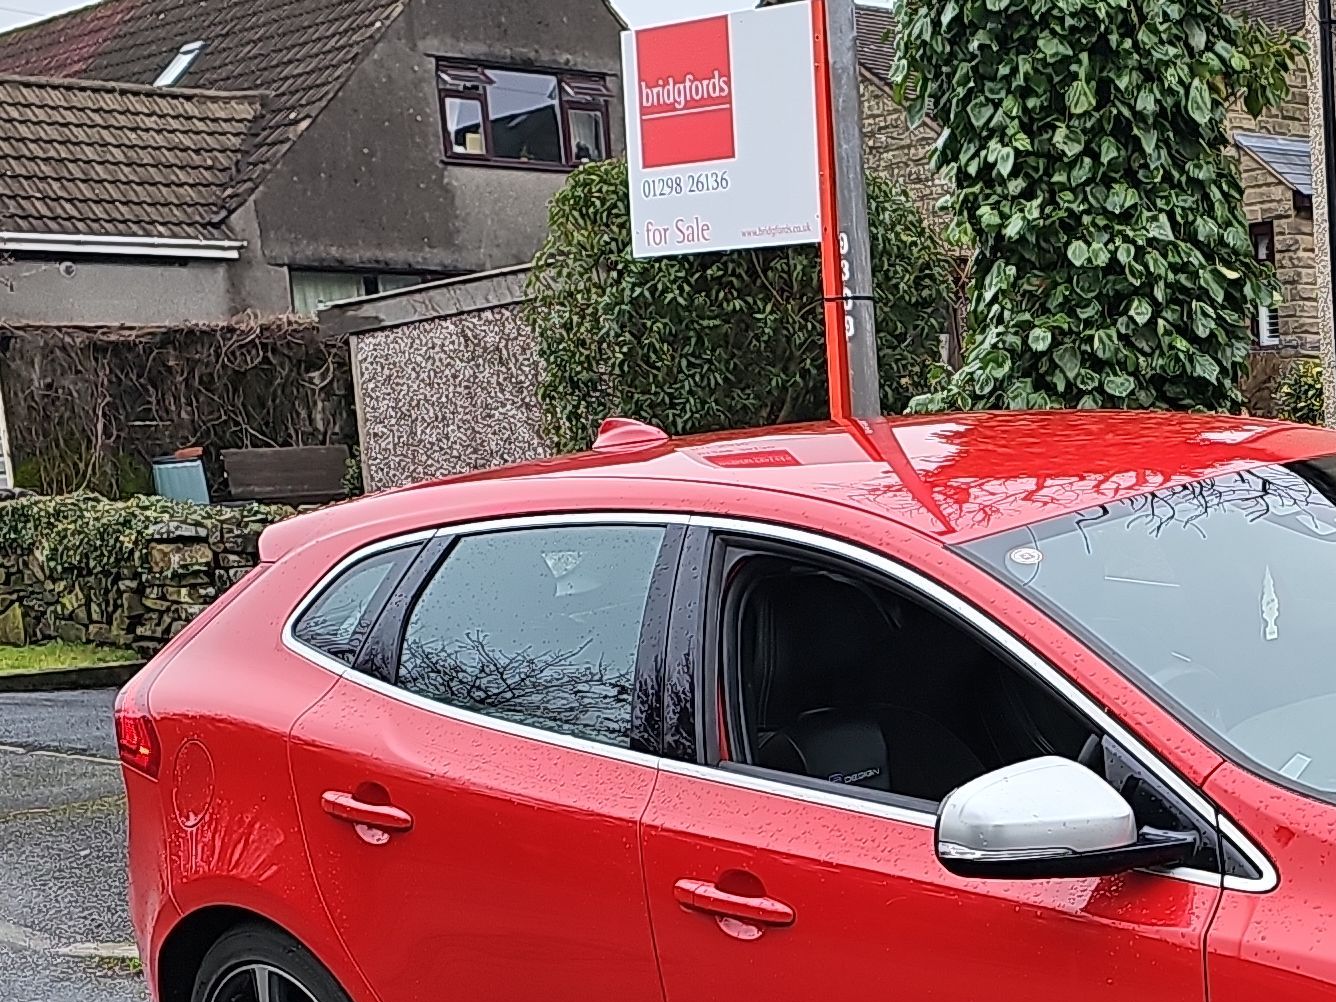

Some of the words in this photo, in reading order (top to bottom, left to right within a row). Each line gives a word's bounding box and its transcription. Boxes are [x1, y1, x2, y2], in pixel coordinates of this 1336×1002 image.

[641, 71, 728, 108] bridgfords
[642, 176, 683, 200] 01298
[687, 171, 729, 194] 26136
[645, 221, 669, 247] for
[675, 217, 710, 244] Sale
